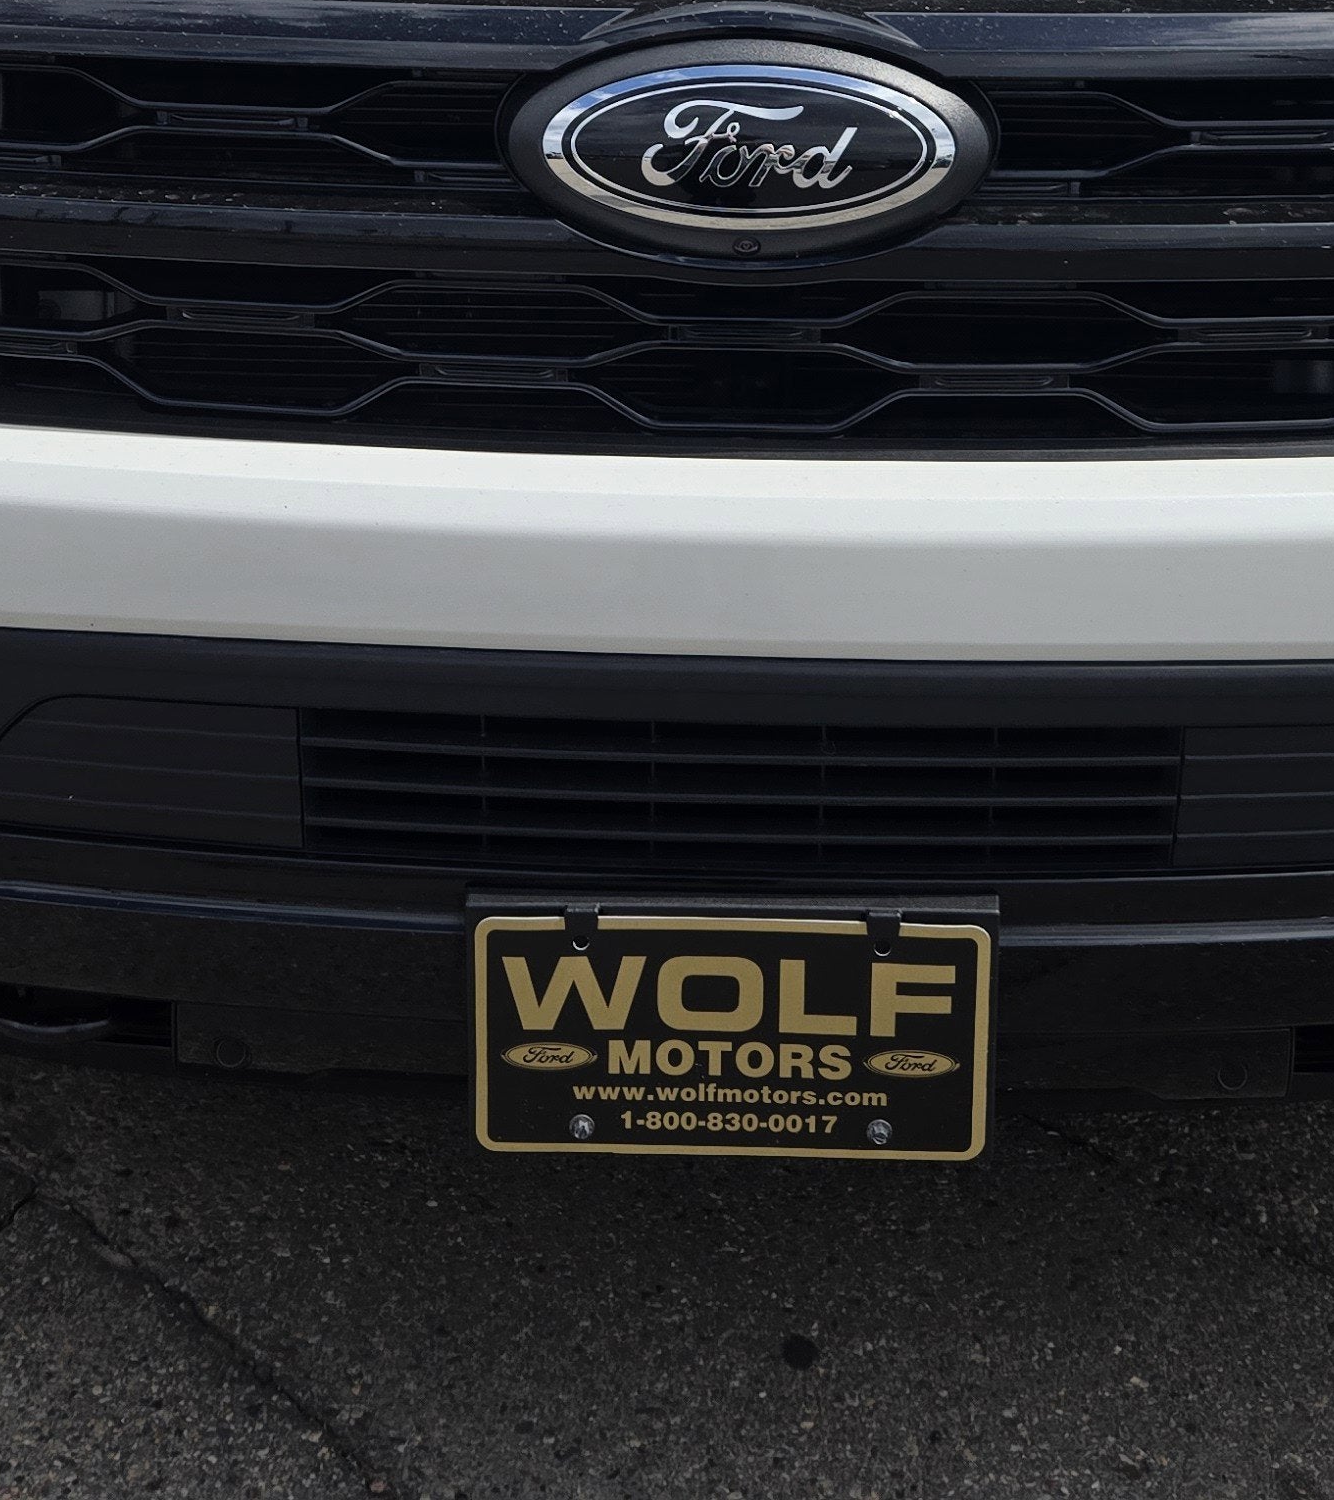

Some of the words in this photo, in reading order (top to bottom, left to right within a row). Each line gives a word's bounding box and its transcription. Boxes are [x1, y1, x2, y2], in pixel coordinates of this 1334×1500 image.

[641, 99, 858, 190] Ford
[501, 955, 956, 1038] WOLF
[523, 1046, 575, 1064] Ford
[607, 1039, 852, 1081] MOTORS
[884, 1053, 938, 1072] Ford
[572, 1082, 888, 1107] www.wolfmotors.com
[620, 1110, 838, 1134] 1-800-830-0017
